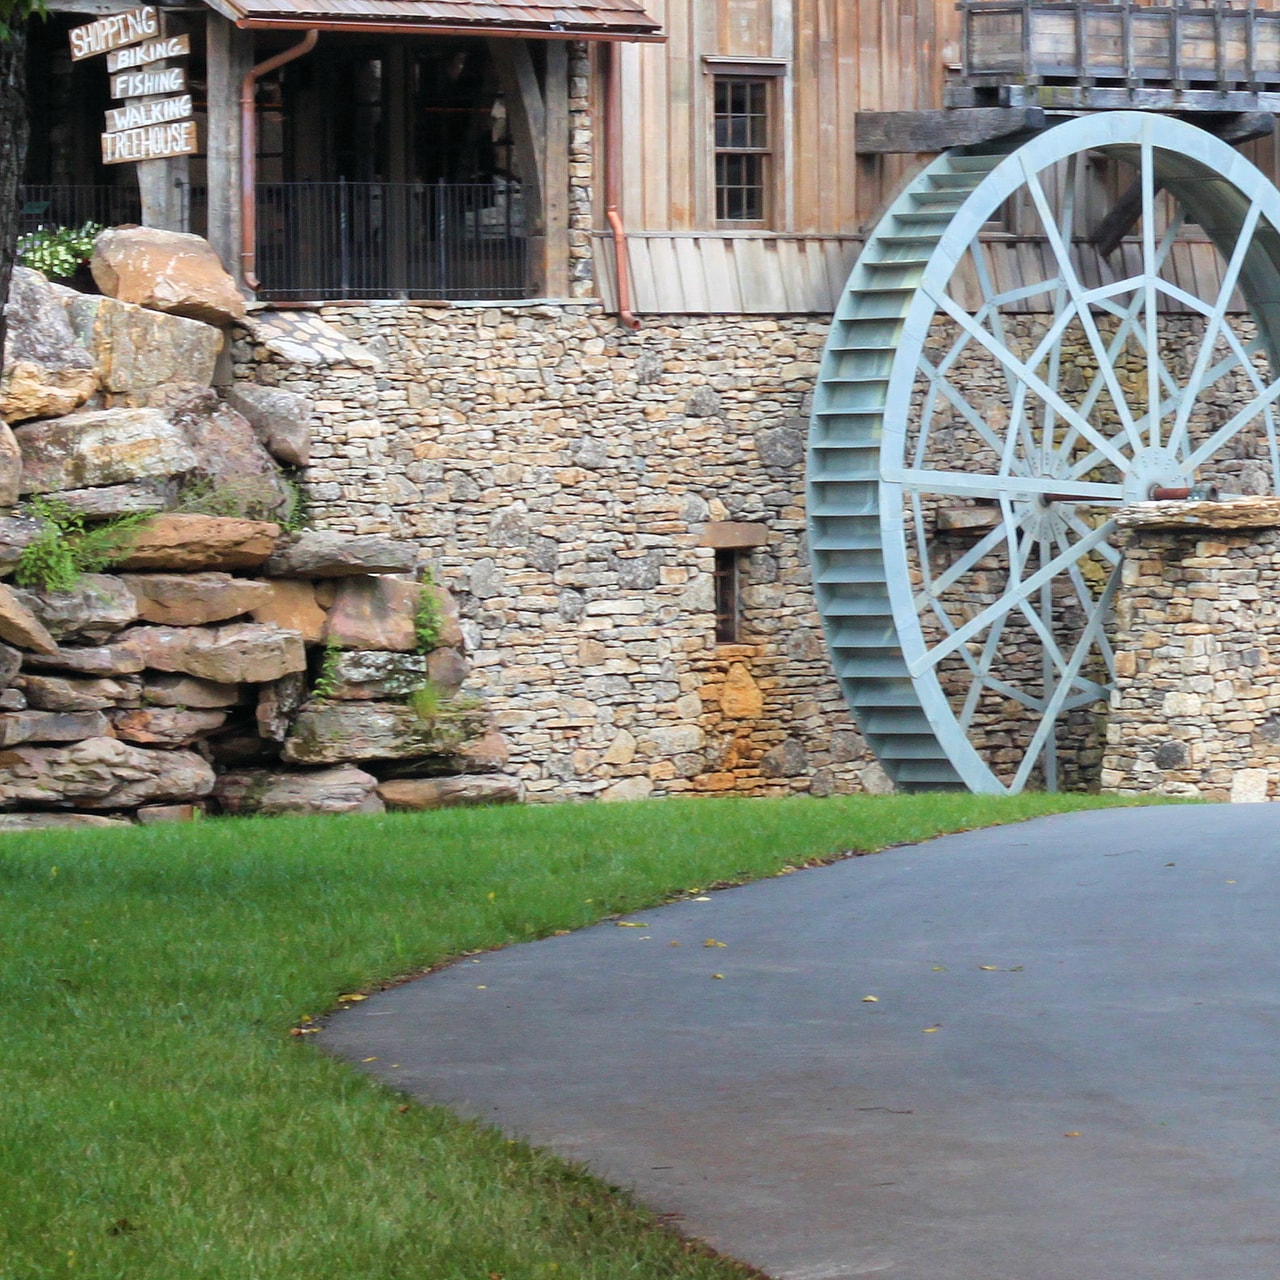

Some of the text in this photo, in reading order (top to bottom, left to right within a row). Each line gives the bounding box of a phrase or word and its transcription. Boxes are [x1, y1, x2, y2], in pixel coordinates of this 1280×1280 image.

[71, 6, 156, 57] SHOPPING
[116, 38, 183, 66] BIKING
[115, 69, 184, 98] FISHING
[113, 94, 192, 130] WALKING
[102, 122, 193, 162] TREEHOUSE
